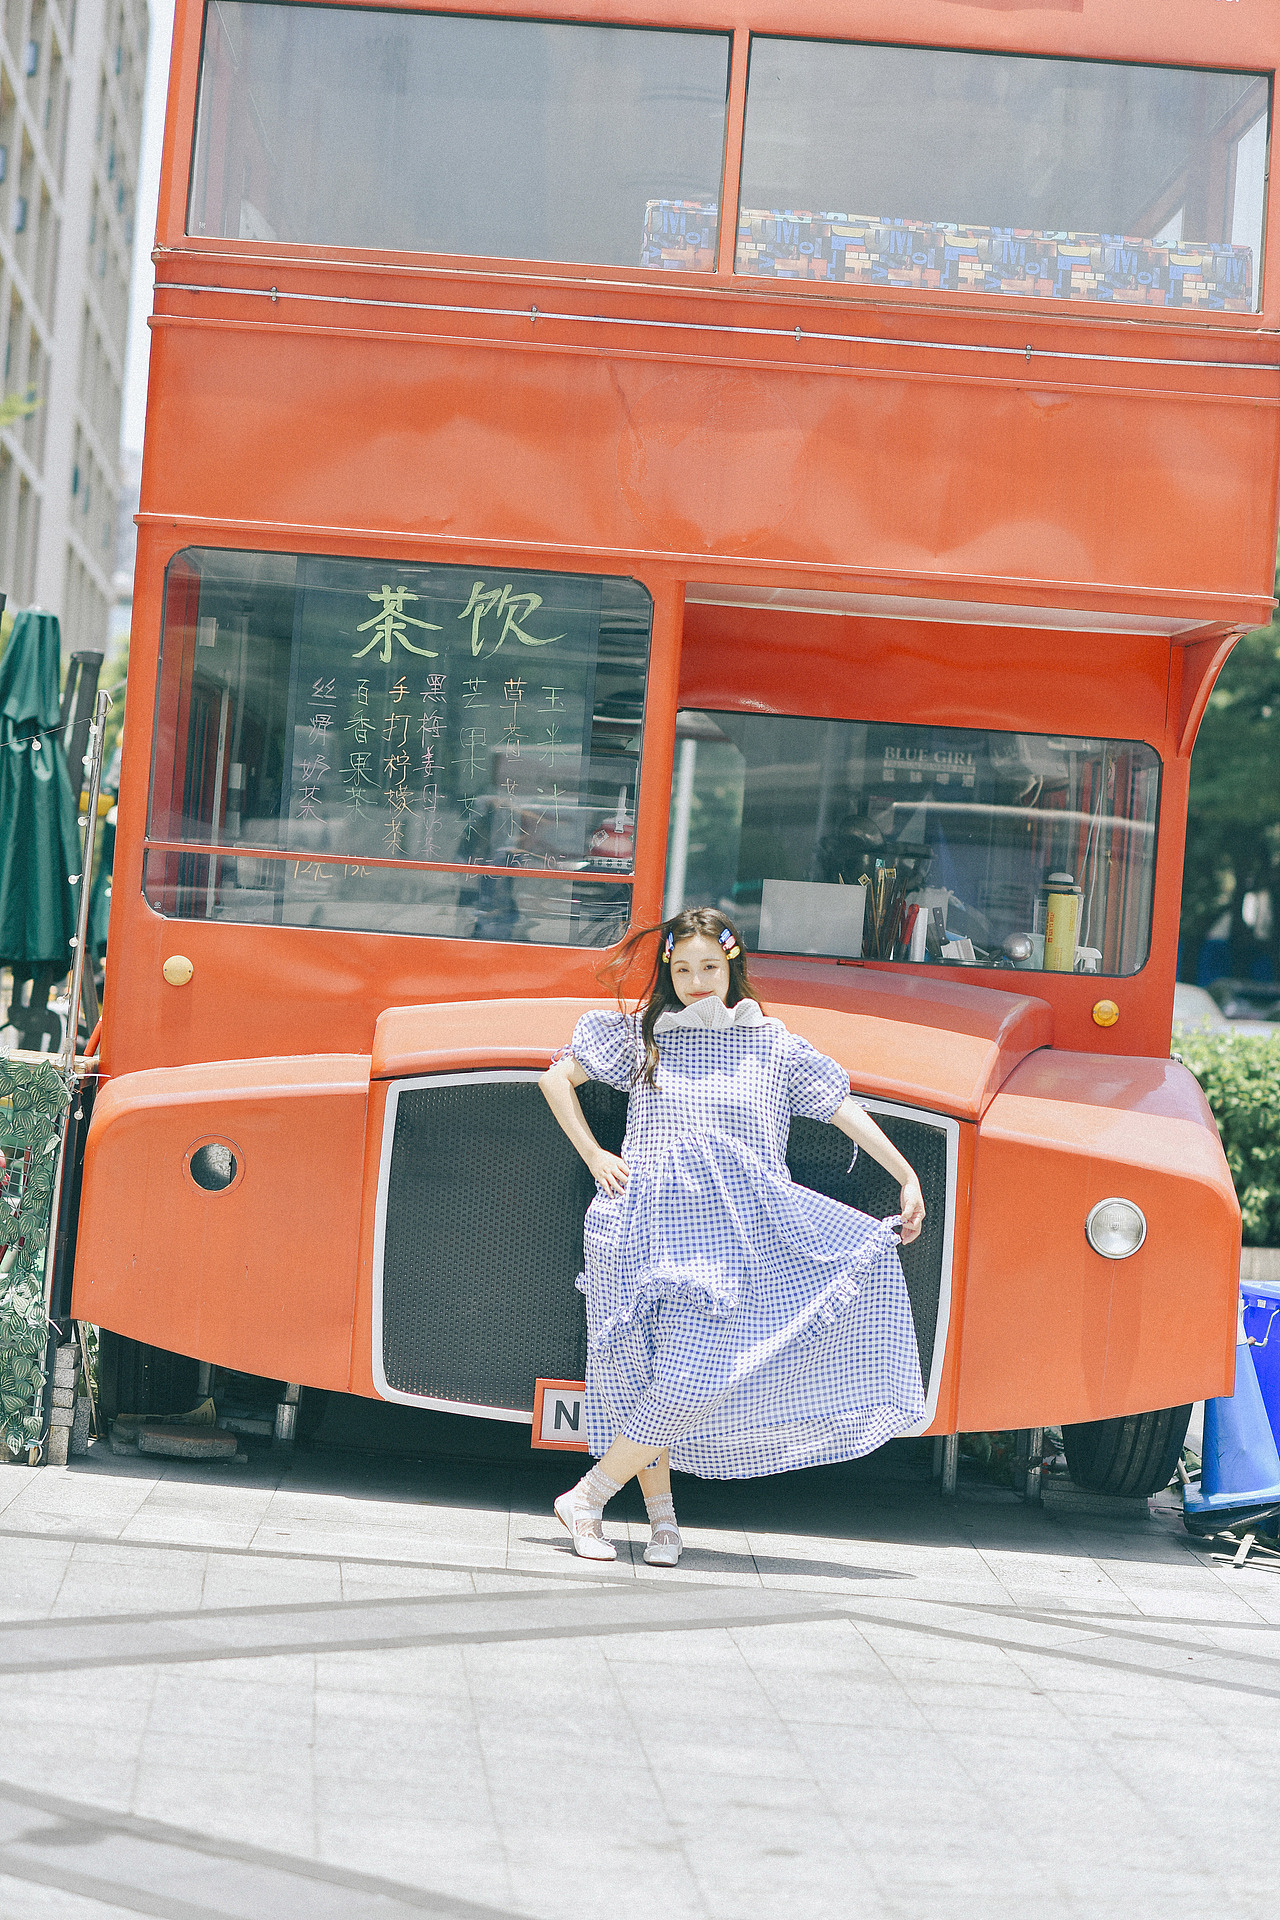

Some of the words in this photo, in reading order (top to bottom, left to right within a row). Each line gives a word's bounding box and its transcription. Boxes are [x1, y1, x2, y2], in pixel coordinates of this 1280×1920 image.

[351, 580, 568, 664] 茶饮
[337, 678, 382, 823] 百香果茶
[535, 686, 569, 834] 玉米汁
[884, 746, 929, 762] BLUE
[933, 750, 975, 766] GIRL
